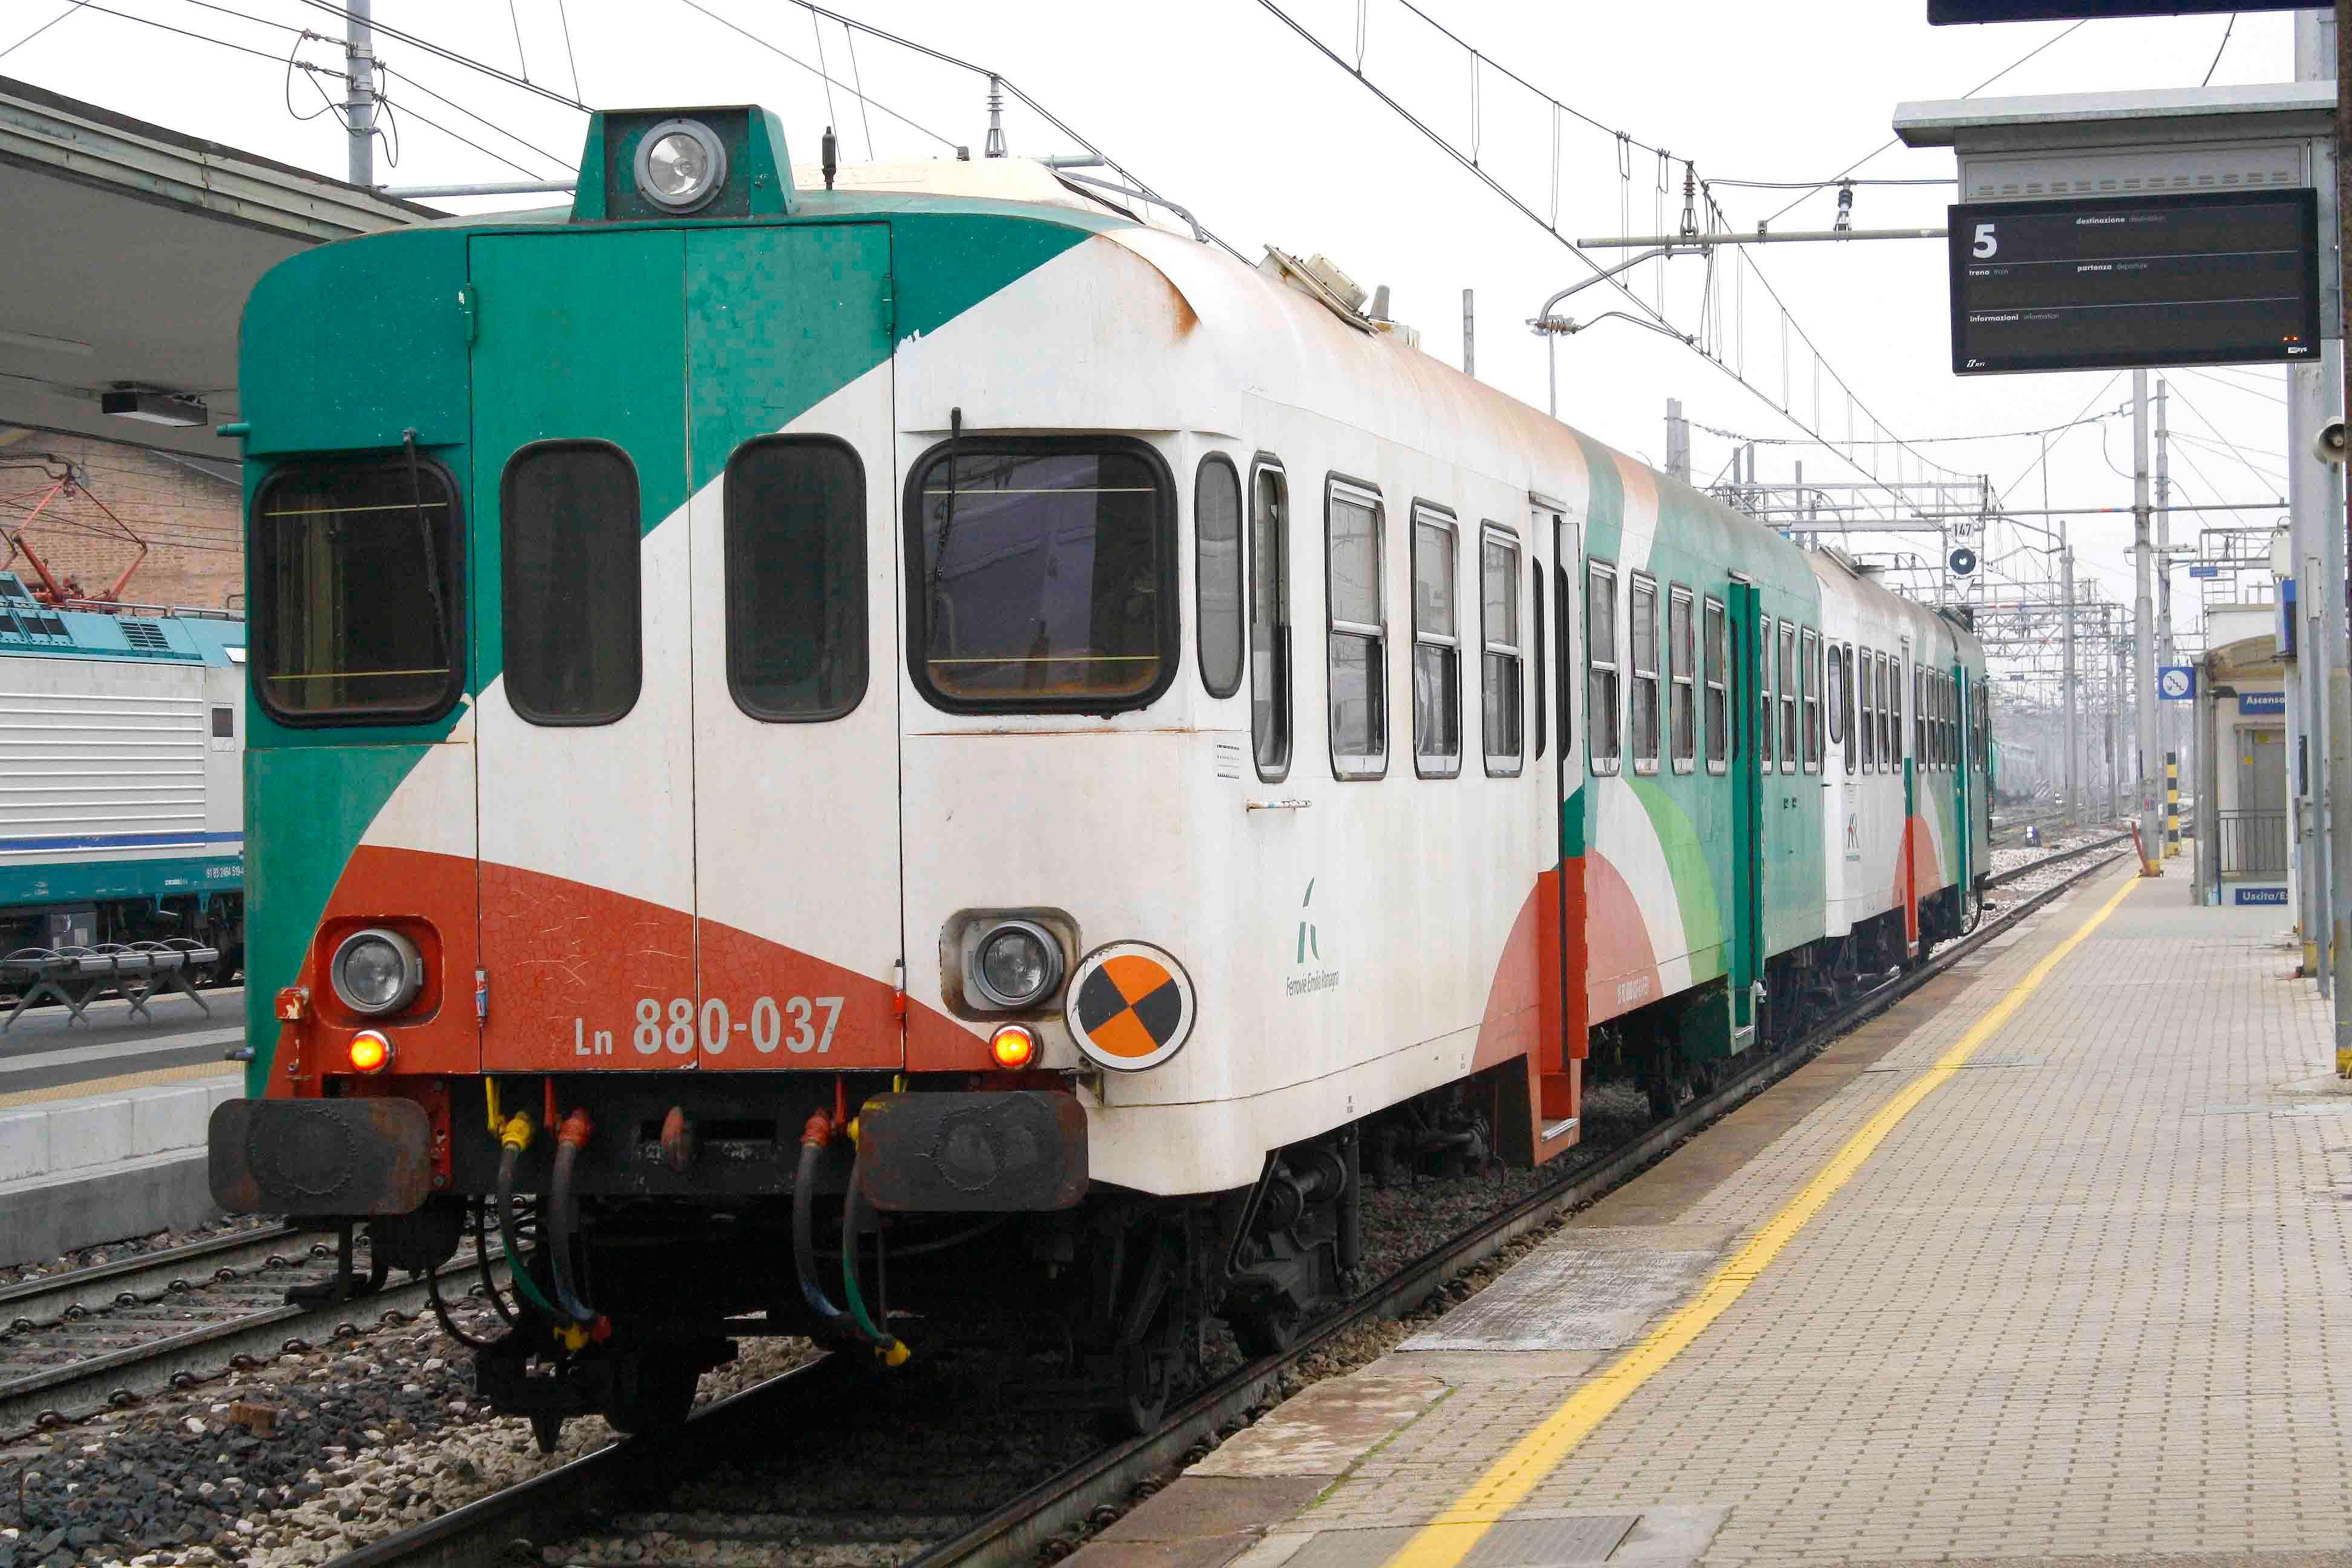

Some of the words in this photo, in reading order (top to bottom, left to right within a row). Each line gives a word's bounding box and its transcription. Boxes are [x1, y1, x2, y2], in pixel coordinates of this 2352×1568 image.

[2076, 215, 2125, 224] destinazione
[1973, 223, 1998, 259] 5
[1970, 314, 2019, 322] informazioni
[1286, 972, 1307, 997] Ferrovie
[1307, 970, 1321, 992] Emilia
[575, 1018, 613, 1055] Ln
[633, 996, 844, 1054] 880-037
